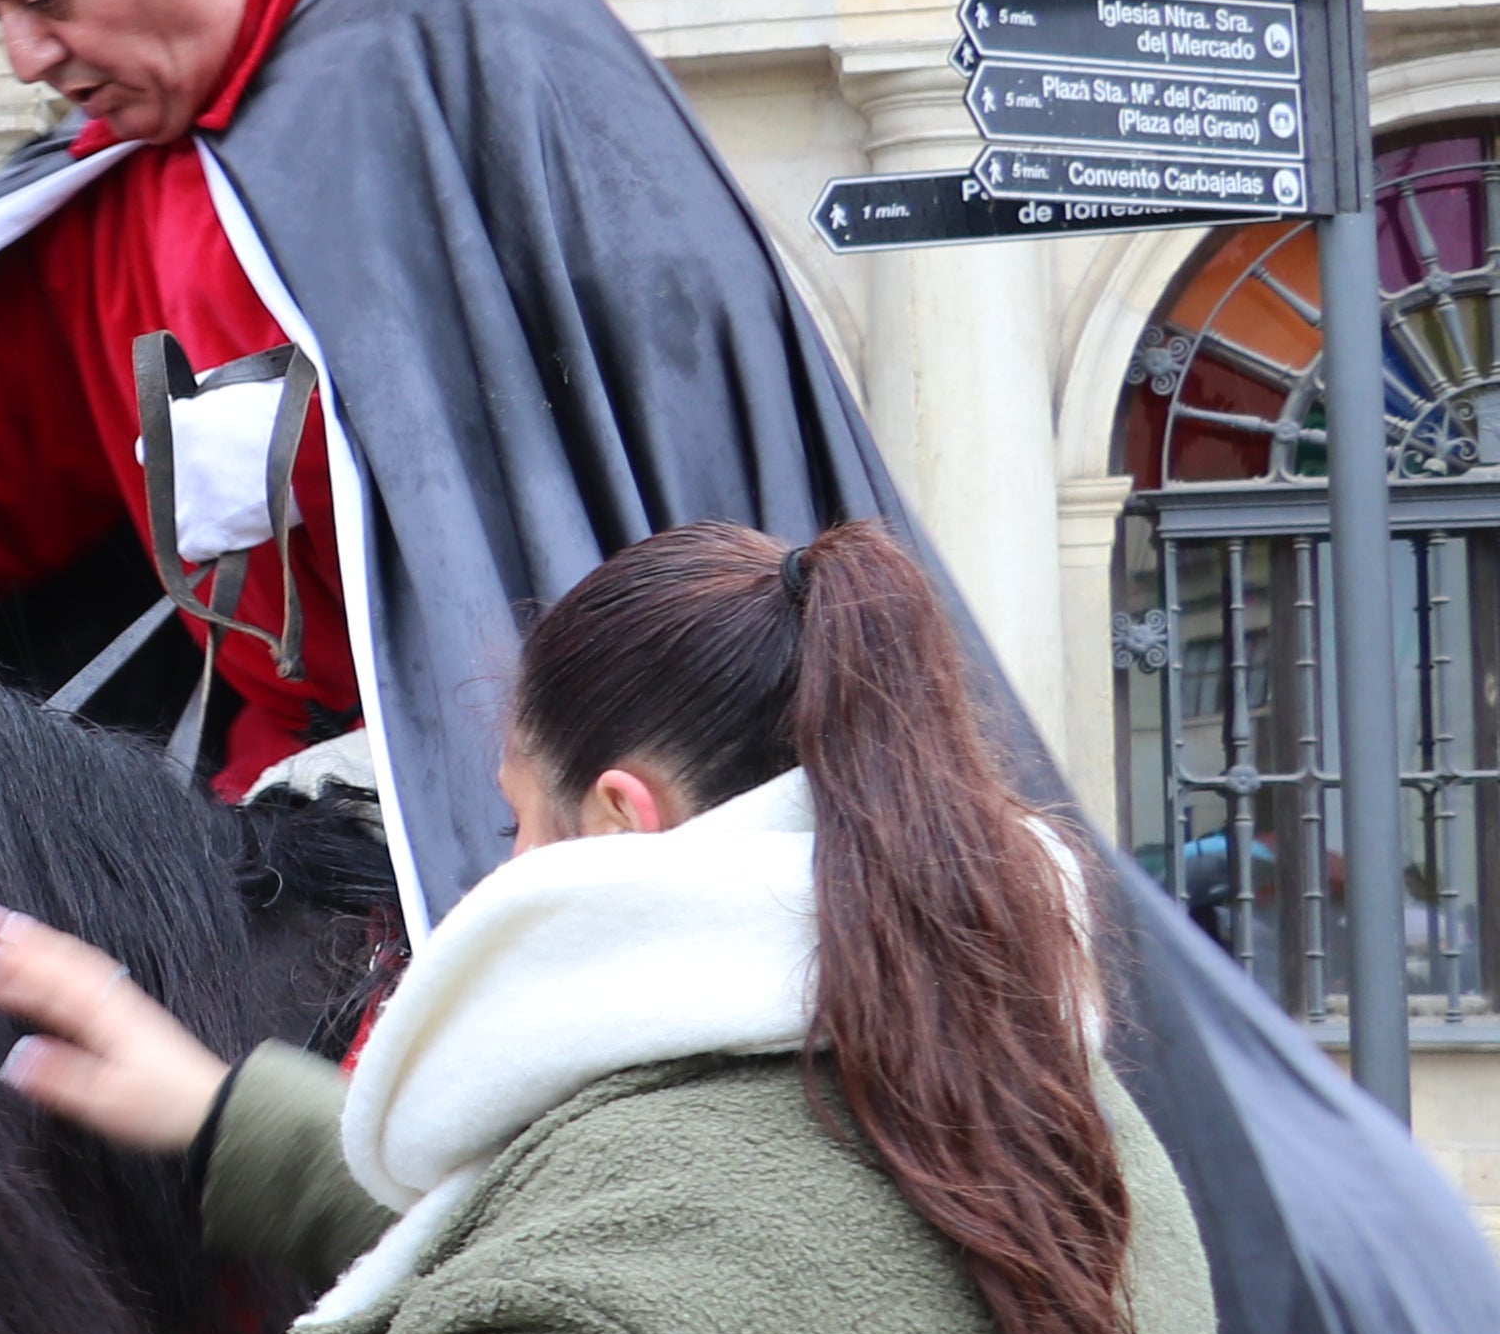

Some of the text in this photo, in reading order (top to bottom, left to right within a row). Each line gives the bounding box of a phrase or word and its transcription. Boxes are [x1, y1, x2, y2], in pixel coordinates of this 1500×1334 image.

[998, 8, 1009, 24] 5
[1098, 0, 1254, 33] Iglesia Ntra. Sra.
[1137, 30, 1256, 60] del Mercado
[1005, 92, 1015, 108] 5
[1043, 76, 1090, 101] Plaza
[1093, 79, 1128, 103] Sta.
[1163, 84, 1190, 108] del
[1193, 86, 1258, 113] Camino
[1118, 109, 1261, 145] (Plaza del Grano)
[1011, 162, 1022, 179] 5
[1068, 161, 1160, 190] Convento
[1164, 166, 1264, 198] Carbajalas
[862, 203, 911, 220] 1 min.
[1018, 200, 1052, 224] de
